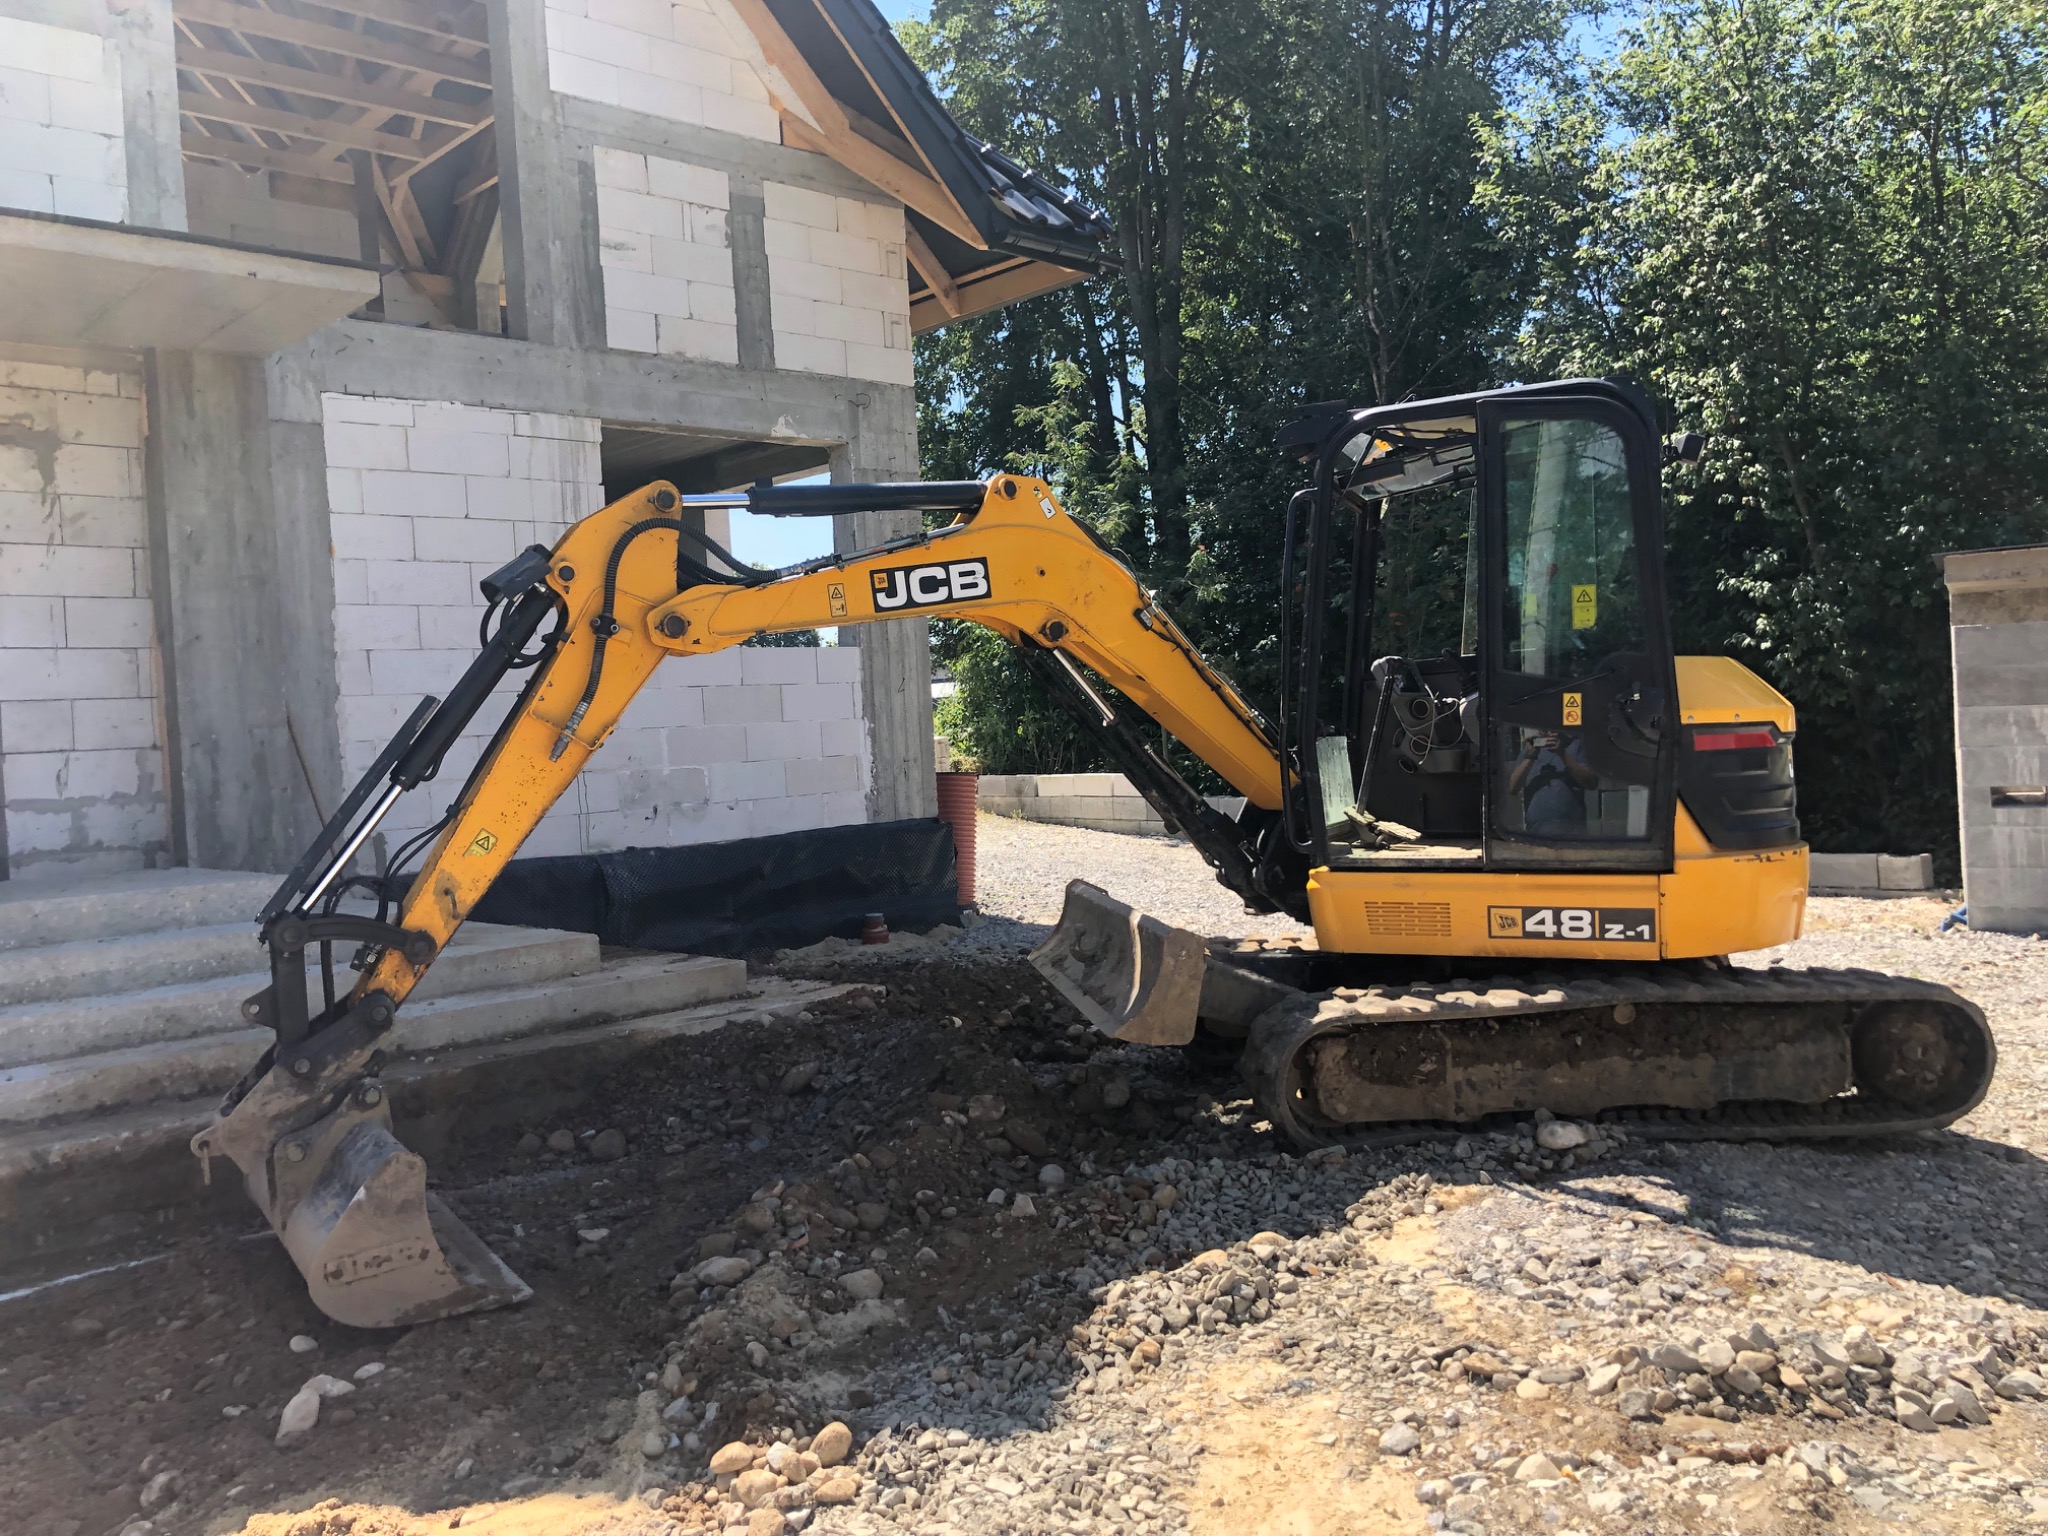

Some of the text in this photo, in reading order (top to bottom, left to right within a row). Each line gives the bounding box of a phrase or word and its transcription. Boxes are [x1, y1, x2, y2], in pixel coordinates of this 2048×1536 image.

[876, 562, 988, 608] JCB
[1498, 914, 1518, 930] JCB
[1525, 909, 1592, 939] 48
